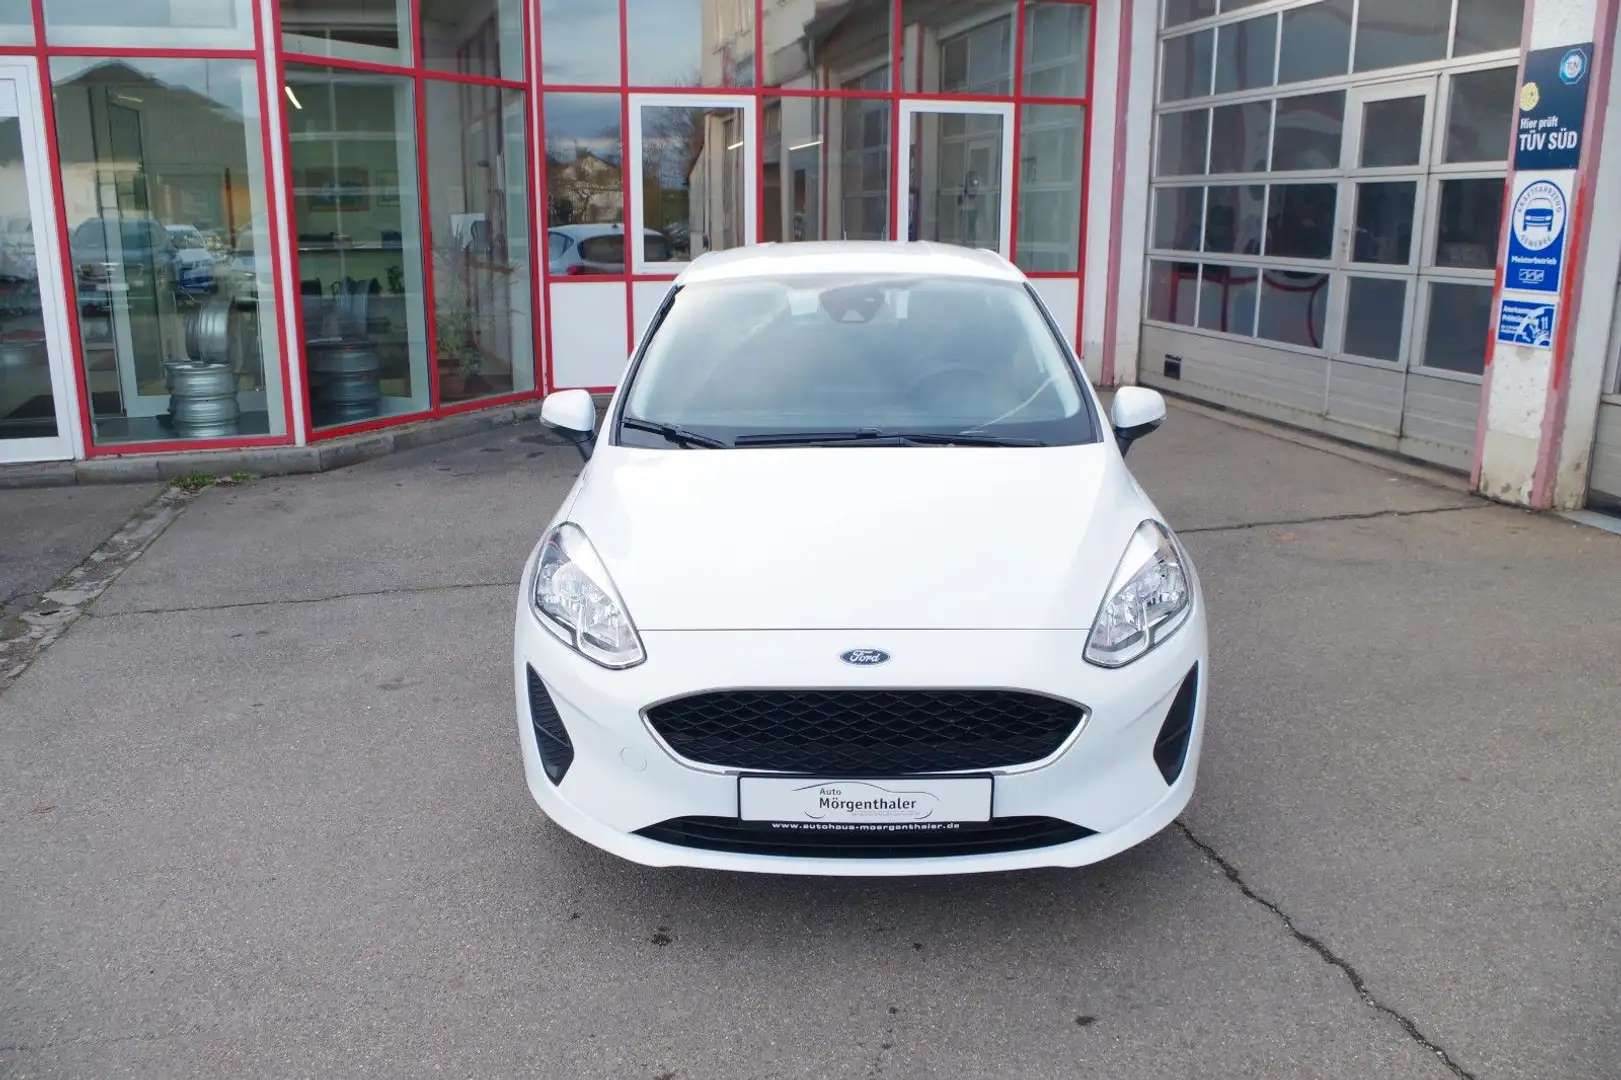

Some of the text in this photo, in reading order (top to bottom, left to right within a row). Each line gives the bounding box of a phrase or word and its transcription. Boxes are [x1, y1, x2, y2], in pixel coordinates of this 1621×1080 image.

[1520, 116, 1558, 130] Hier prüft
[1519, 128, 1578, 151] TÜV SÜD
[1511, 255, 1557, 265] Meisterbetrieb
[850, 650, 881, 662] Ford
[819, 787, 842, 796] Auto
[819, 797, 917, 812] Mörgenthaler
[771, 822, 960, 831] www.autohaus-moergenthaler.de
